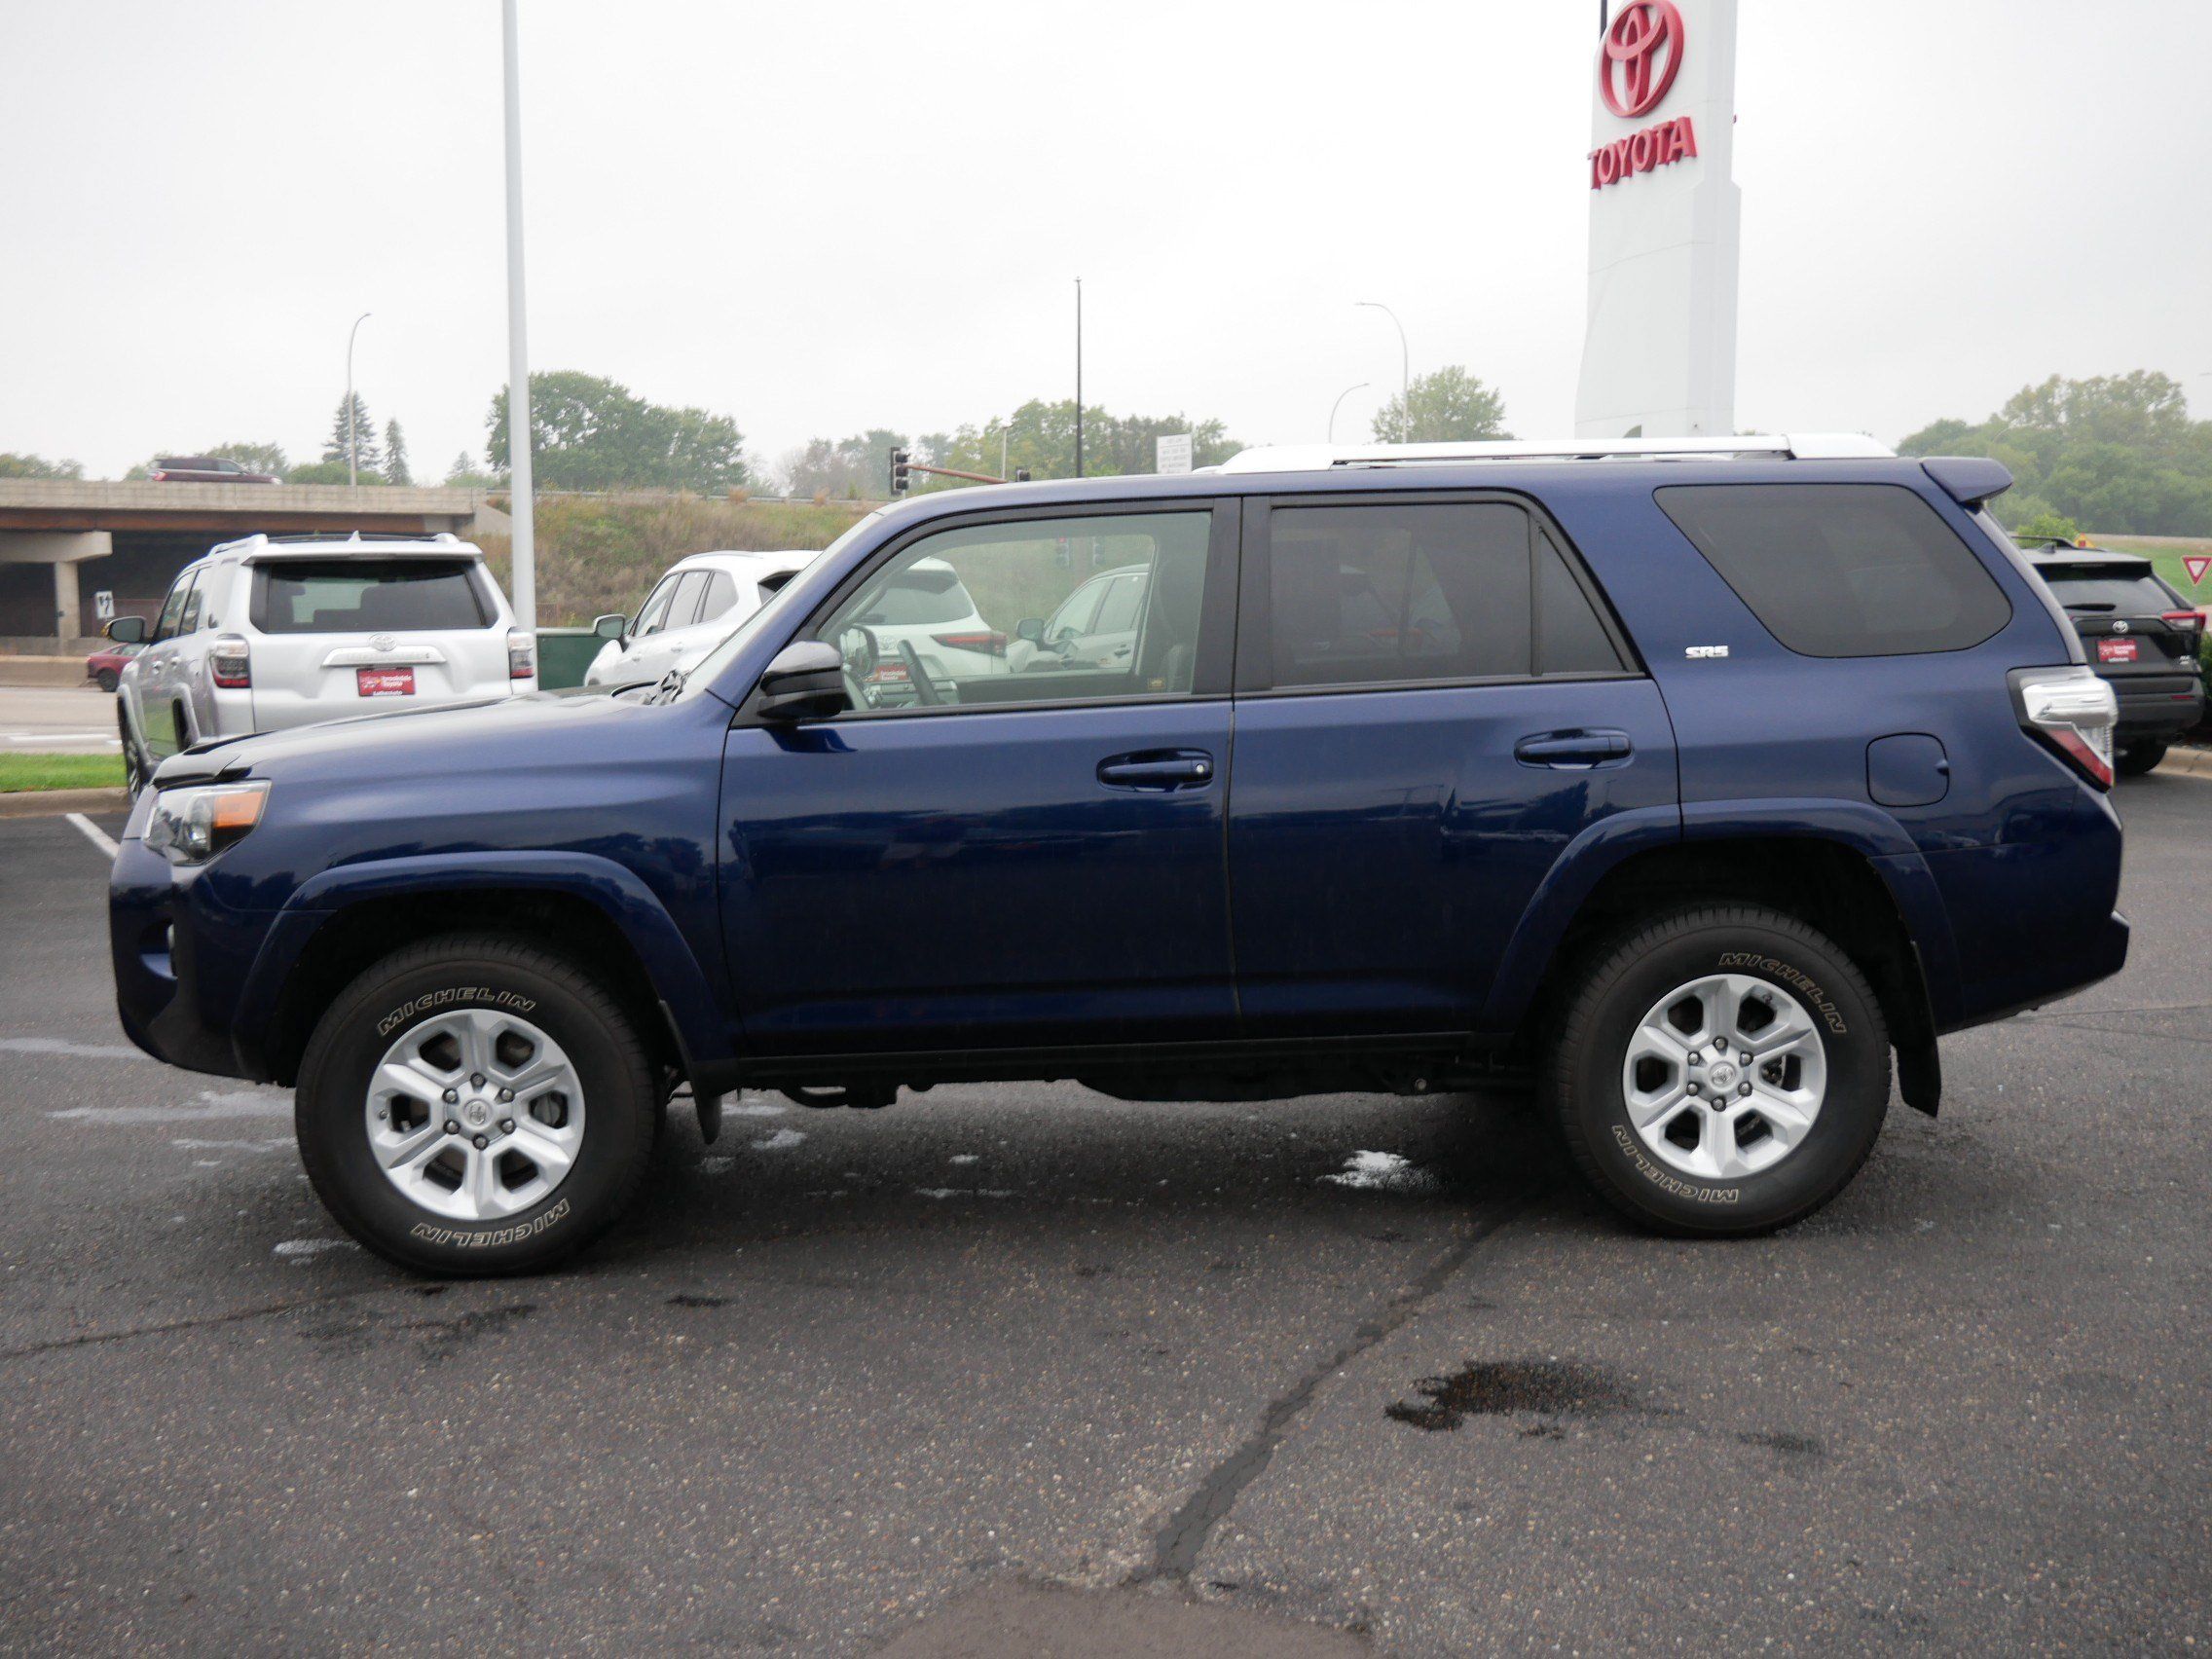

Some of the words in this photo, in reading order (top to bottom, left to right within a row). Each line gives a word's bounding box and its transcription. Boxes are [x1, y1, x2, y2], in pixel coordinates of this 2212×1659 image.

[1588, 116, 1697, 190] TOYOTA
[1685, 645, 1728, 659] SR5
[376, 986, 535, 1037] MICHELIN
[1717, 952, 1848, 1035] MICHELIN
[1611, 1124, 1740, 1205] MICHELIN
[410, 1198, 571, 1247] MICHELIN
